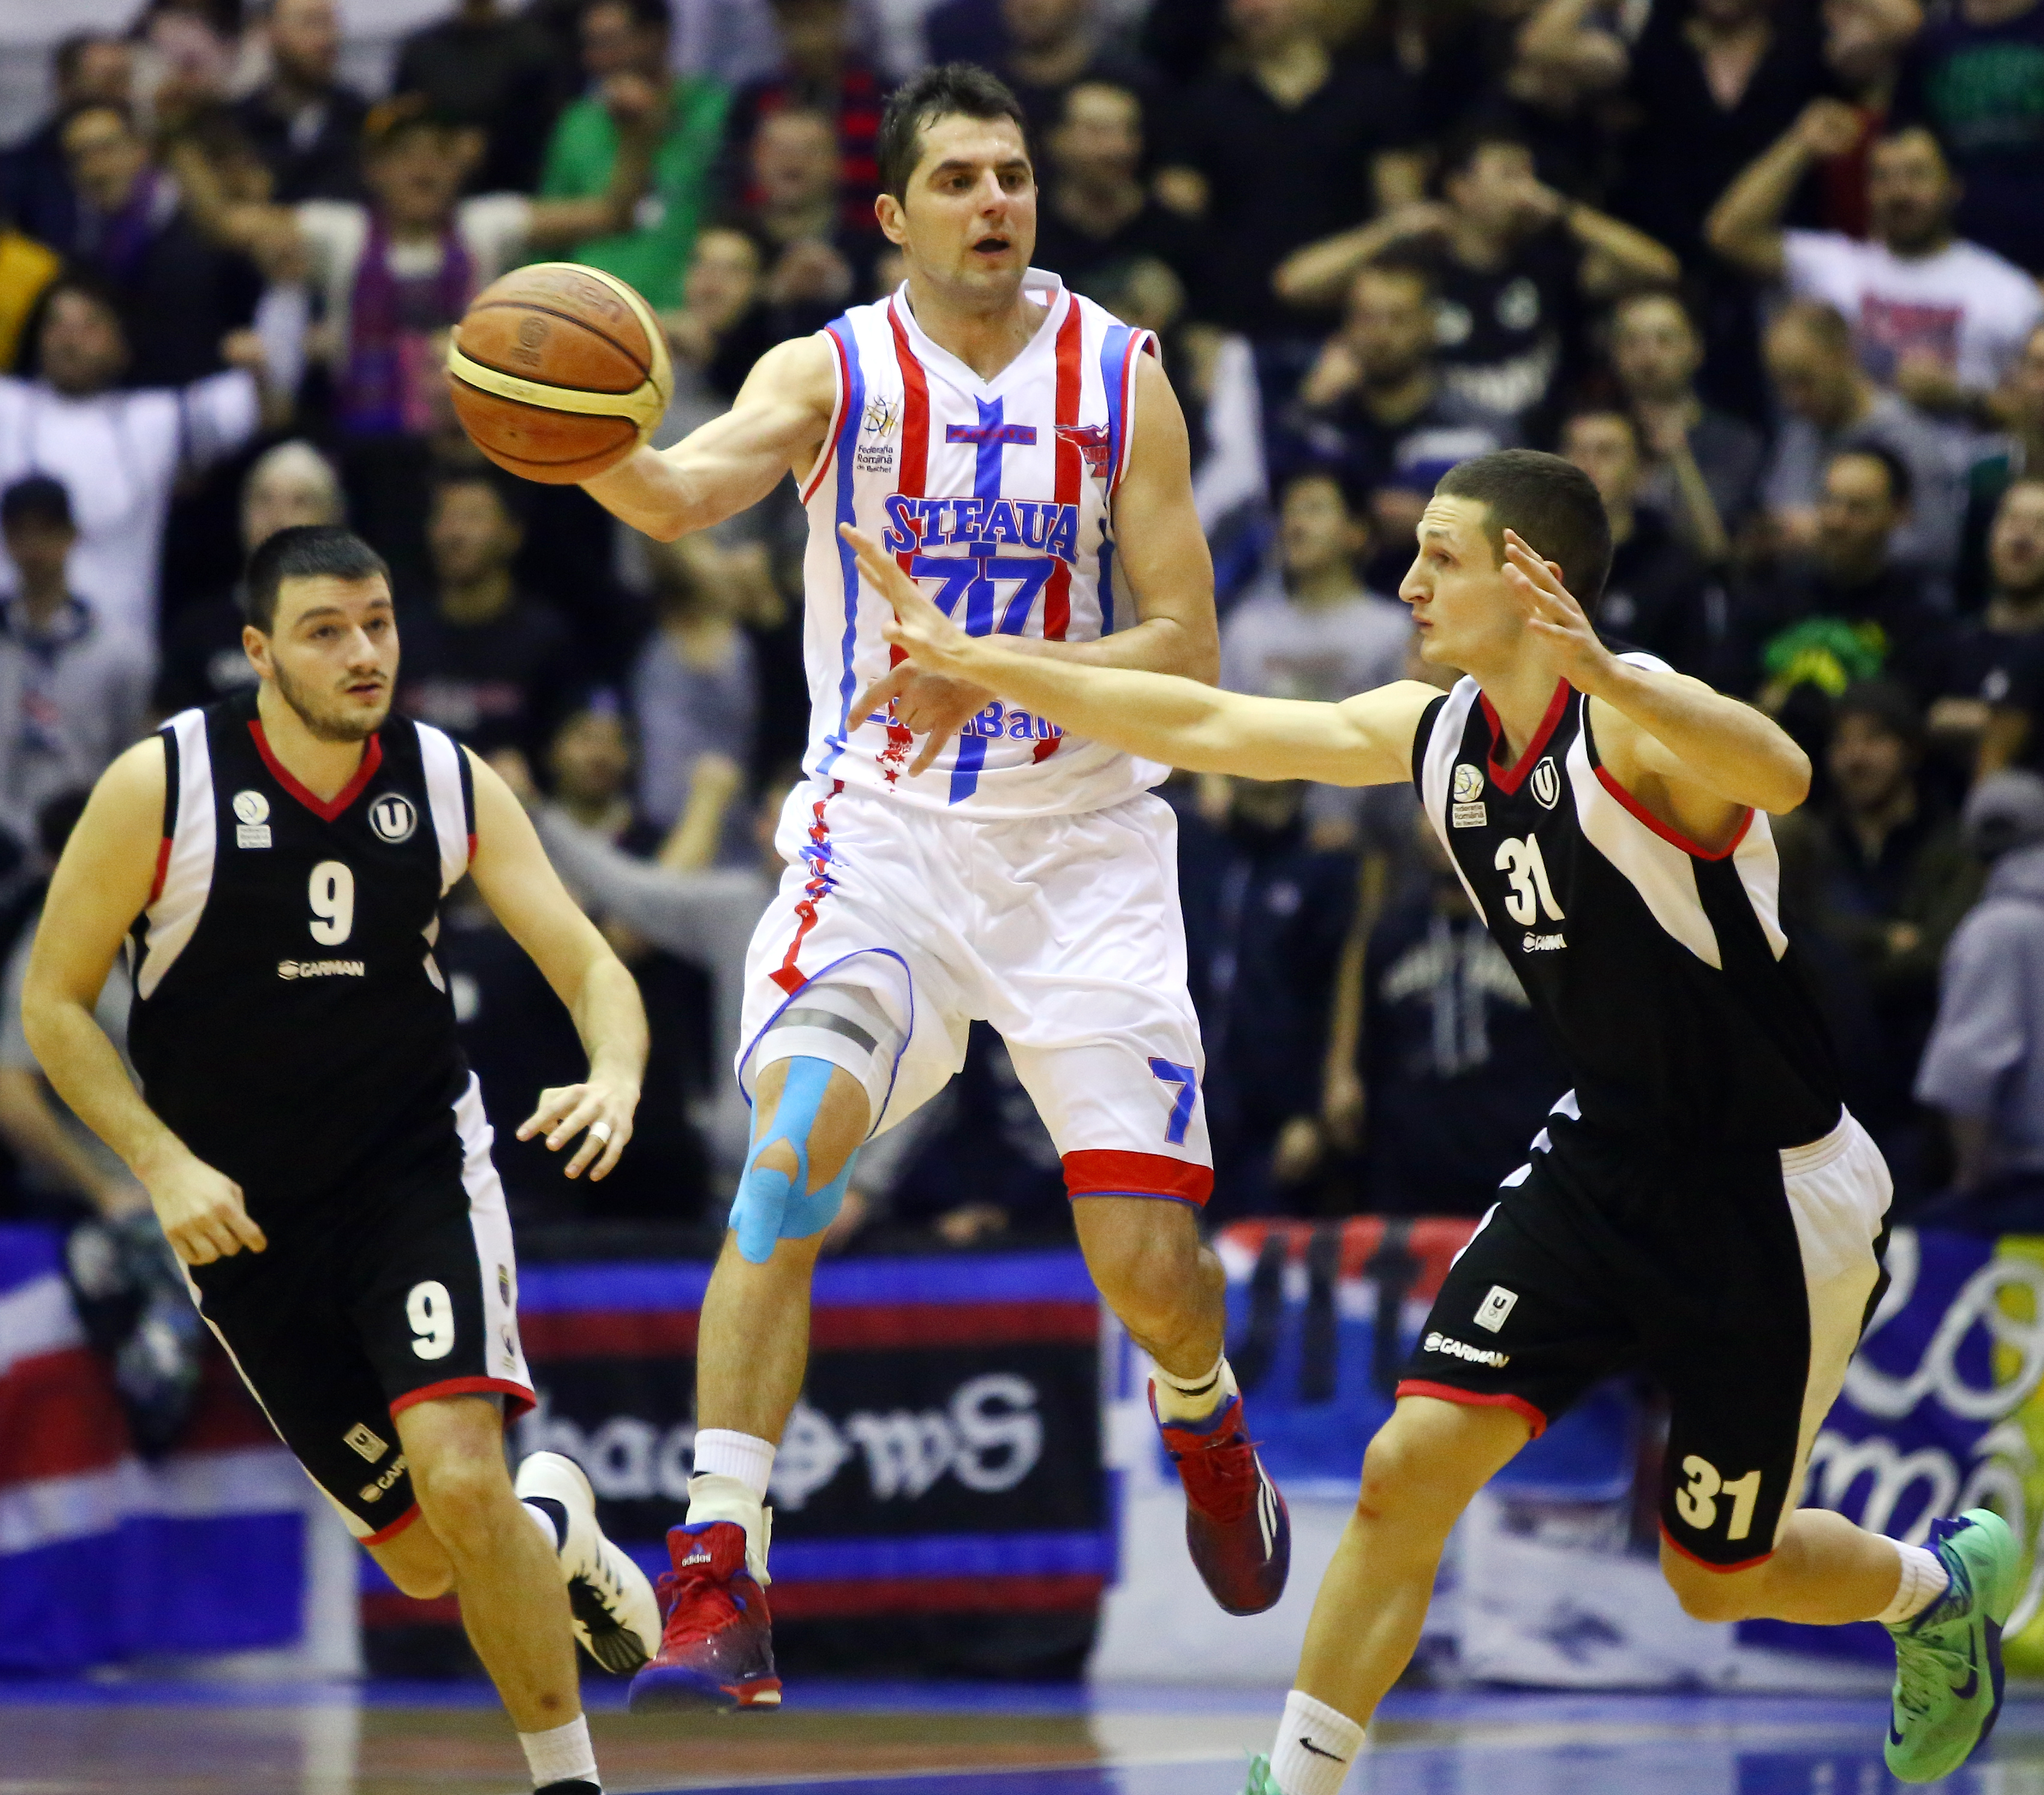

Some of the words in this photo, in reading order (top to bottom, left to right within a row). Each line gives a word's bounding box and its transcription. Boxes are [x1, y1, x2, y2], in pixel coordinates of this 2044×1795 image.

[882, 493, 1080, 565] STEAUA
[910, 555, 1056, 635] 77
[376, 803, 409, 838] U
[309, 860, 354, 946] 9
[1494, 833, 1566, 926] 31
[1148, 1056, 1196, 1147] 7
[405, 1280, 455, 1360] 9
[1440, 1337, 1511, 1369] GARMAN
[1675, 1454, 1762, 1540] 31
[681, 1552, 712, 1567] adidas
